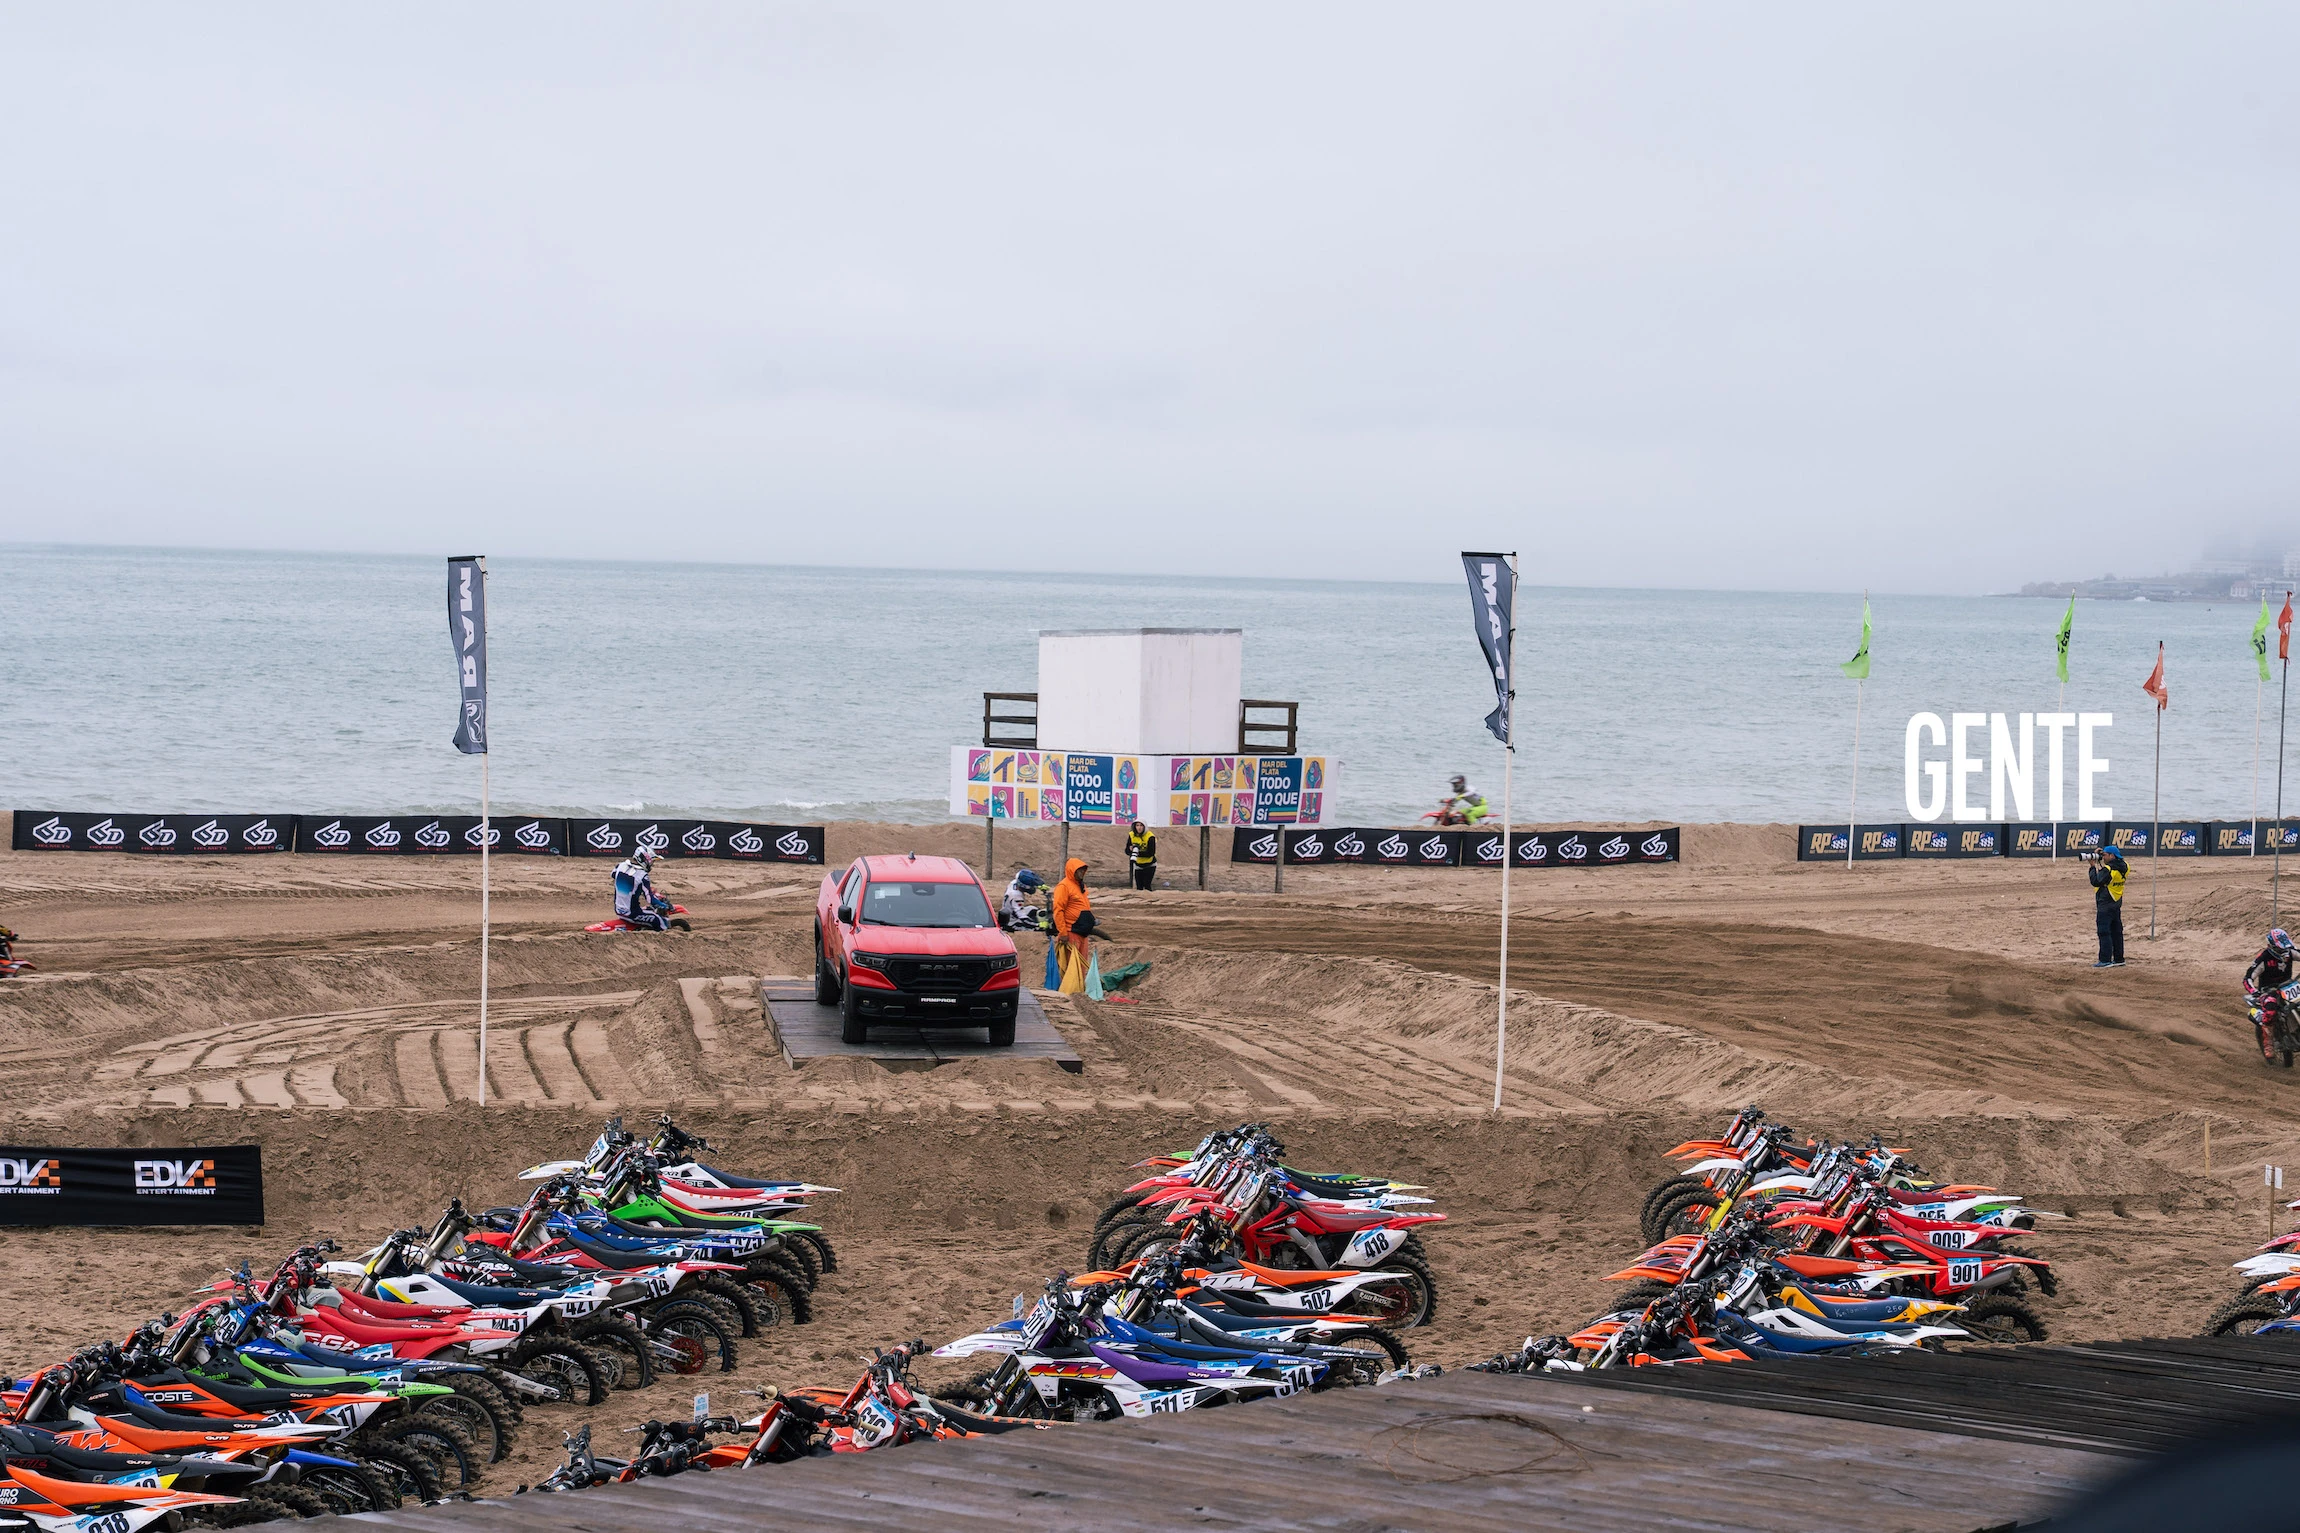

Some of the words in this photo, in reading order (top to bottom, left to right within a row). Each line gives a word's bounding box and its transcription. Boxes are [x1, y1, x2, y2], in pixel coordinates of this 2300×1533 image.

[1069, 757, 1085, 765] MAR
[1085, 758, 1097, 766] DEL
[1069, 765, 1089, 773] PLATA
[1069, 773, 1101, 788] TODO
[1261, 768, 1279, 776] PLATA
[1260, 776, 1291, 790] TODO
[1069, 789, 1084, 803] LO
[1085, 790, 1111, 805] QUE
[1258, 792, 1273, 806] LO
[1274, 792, 1298, 806] QUE
[1068, 805, 1080, 819] Sí
[1256, 807, 1268, 821] Sí
[1810, 832, 1832, 854] RP
[1861, 831, 1883, 853] RP
[1910, 830, 1932, 851] RP
[1961, 830, 1981, 851] RP
[2016, 829, 2038, 851] RP
[2066, 829, 2086, 850] RP
[2112, 828, 2132, 849] RP
[2161, 829, 2181, 850] RP
[2218, 829, 2238, 850] RP
[0, 1187, 61, 1195] ERTAINMENT
[136, 1187, 217, 1195] ENTERTAINMENT
[1364, 1232, 1390, 1258] 418
[1952, 1263, 1979, 1283] 901
[1300, 1289, 1334, 1310] 502
[1885, 1305, 1903, 1314] 250
[418, 1365, 448, 1373] DUNLOP
[1028, 1361, 1119, 1380] KTM
[1279, 1365, 1311, 1396] 514
